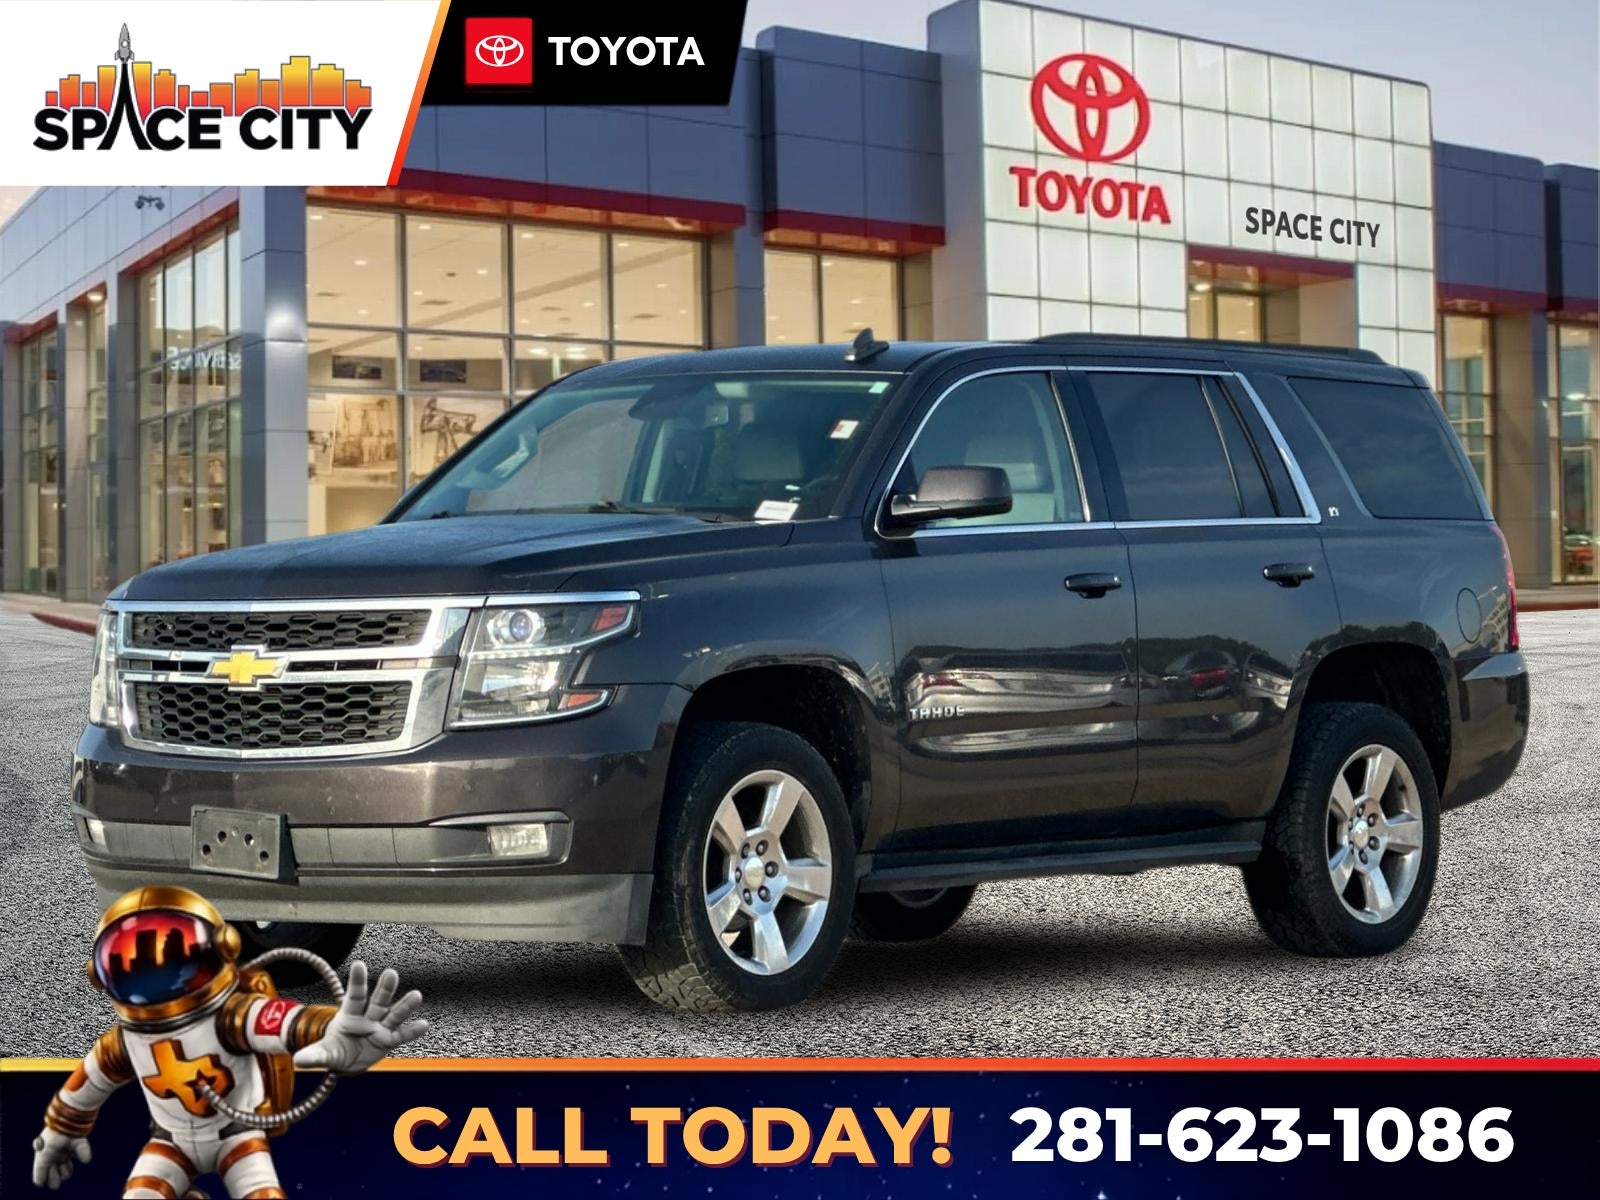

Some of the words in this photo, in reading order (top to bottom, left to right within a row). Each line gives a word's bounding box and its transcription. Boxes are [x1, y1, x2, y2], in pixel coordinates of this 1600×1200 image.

[1009, 166, 1171, 224] TOYOTA
[1245, 206, 1323, 242] SPACE
[1329, 218, 1381, 248] CITY
[909, 705, 965, 720] TAHOE
